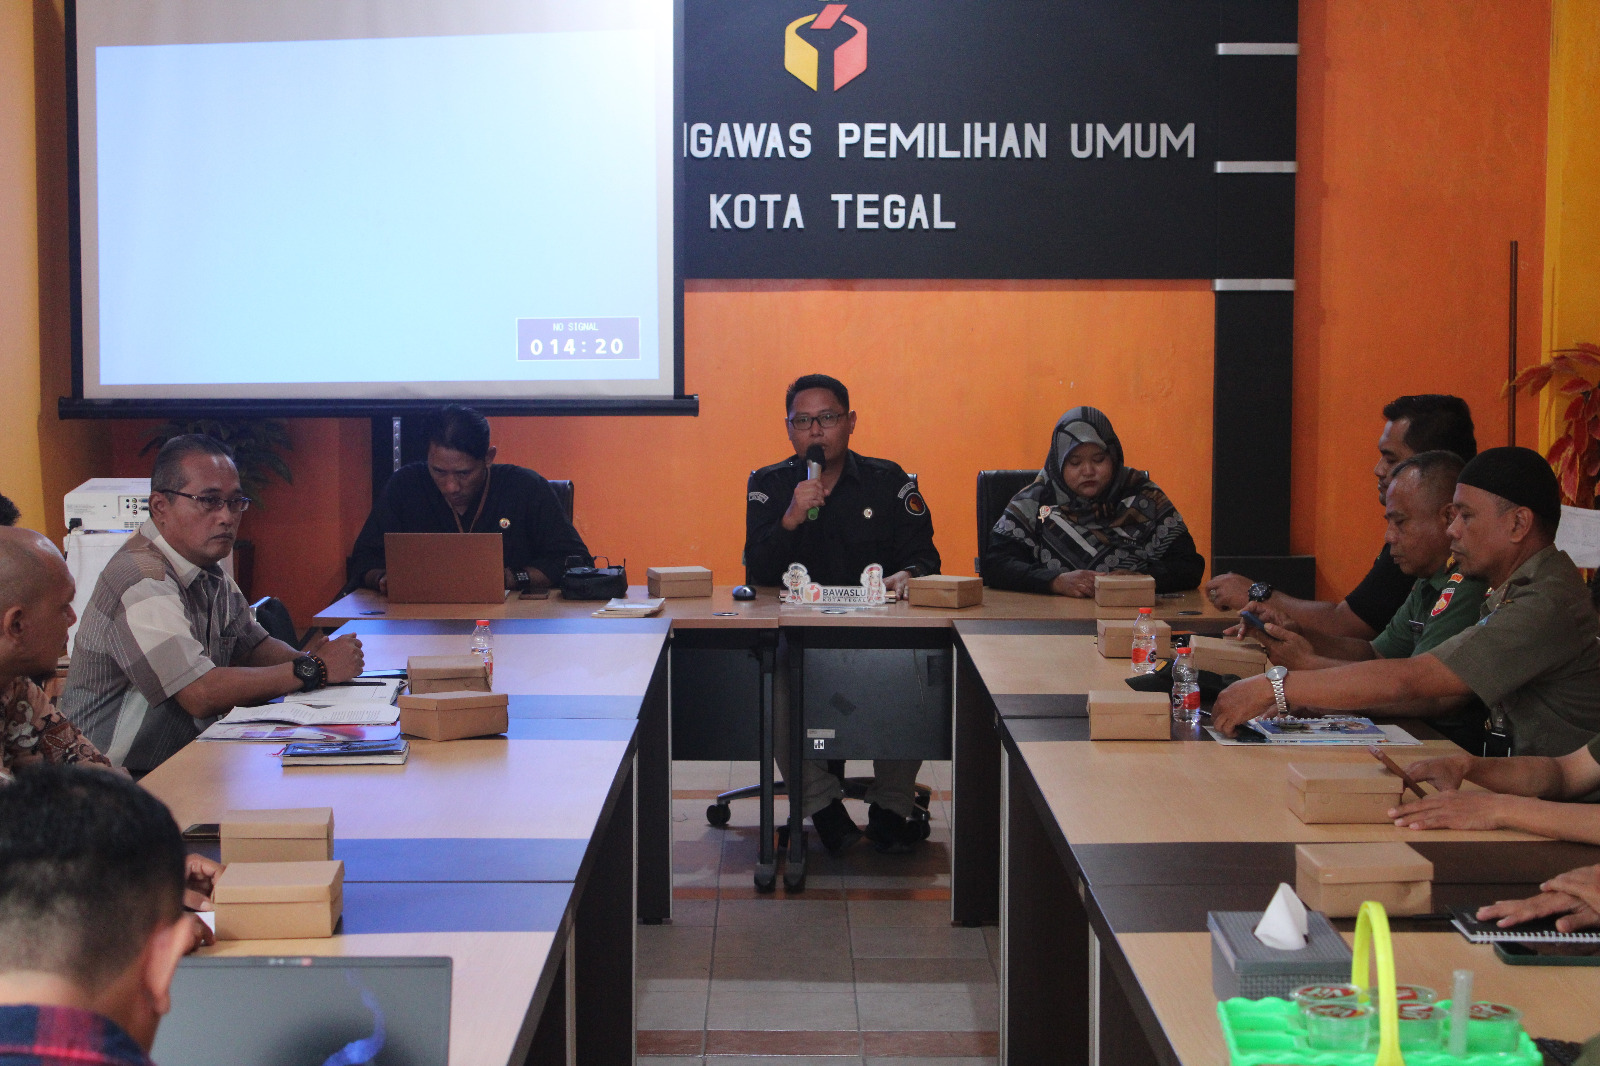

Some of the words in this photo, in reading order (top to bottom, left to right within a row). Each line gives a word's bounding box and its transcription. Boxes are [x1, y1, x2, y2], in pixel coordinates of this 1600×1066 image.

[683, 122, 812, 159] GAWAS
[838, 122, 1047, 159] PEMILIHAN
[1070, 122, 1195, 159] UMUM
[709, 193, 805, 229] KOTA
[830, 193, 956, 230] TEGAL
[552, 322, 564, 332] NO
[568, 322, 599, 331] SIGNAL
[822, 588, 867, 597] BAWASLU
